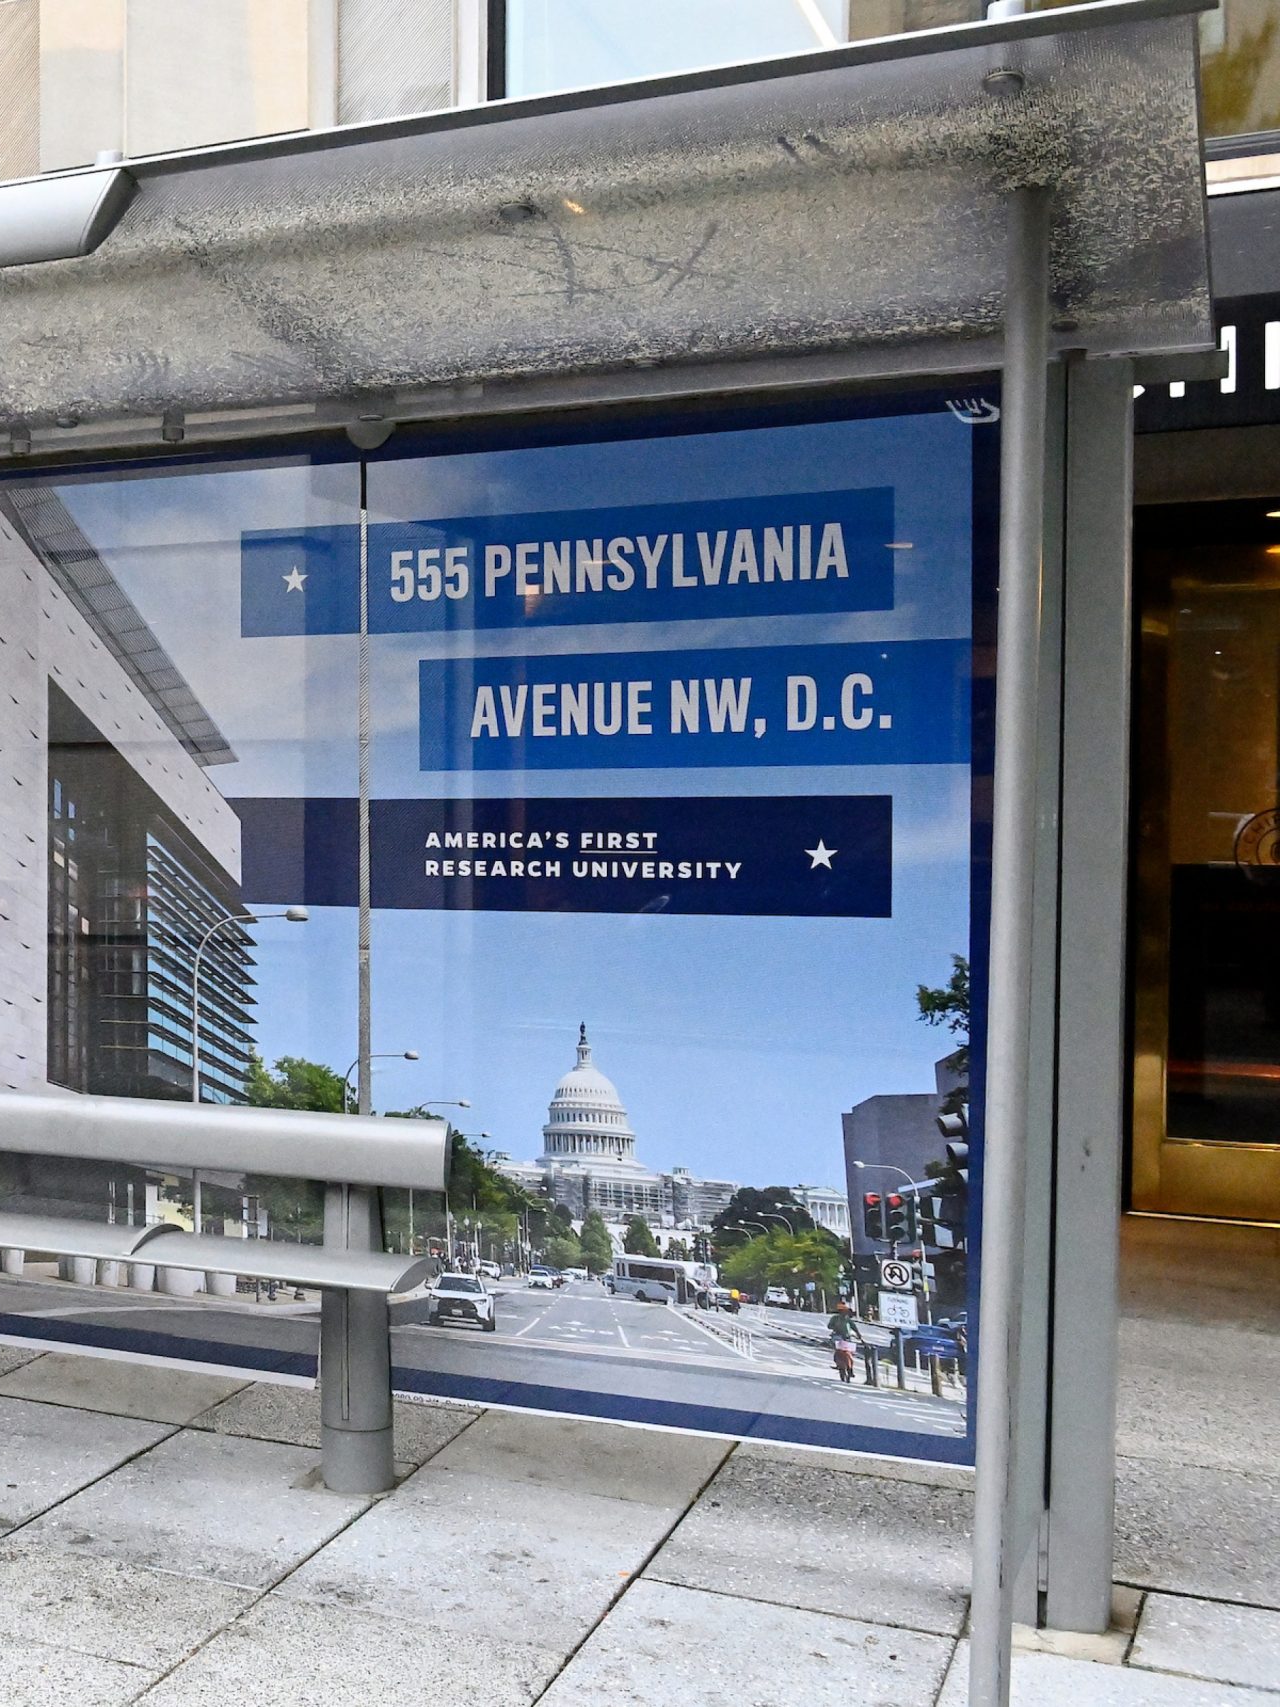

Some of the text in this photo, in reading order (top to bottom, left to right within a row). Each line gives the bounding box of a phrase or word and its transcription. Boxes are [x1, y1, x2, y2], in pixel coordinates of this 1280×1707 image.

[390, 522, 849, 602] 555 PENNSYLVANIA
[470, 672, 893, 739] AVENUE NW, D.C.
[425, 831, 658, 849] AMERICA'S FIRST
[425, 860, 742, 879] RESEARCH UNIVERSITY
